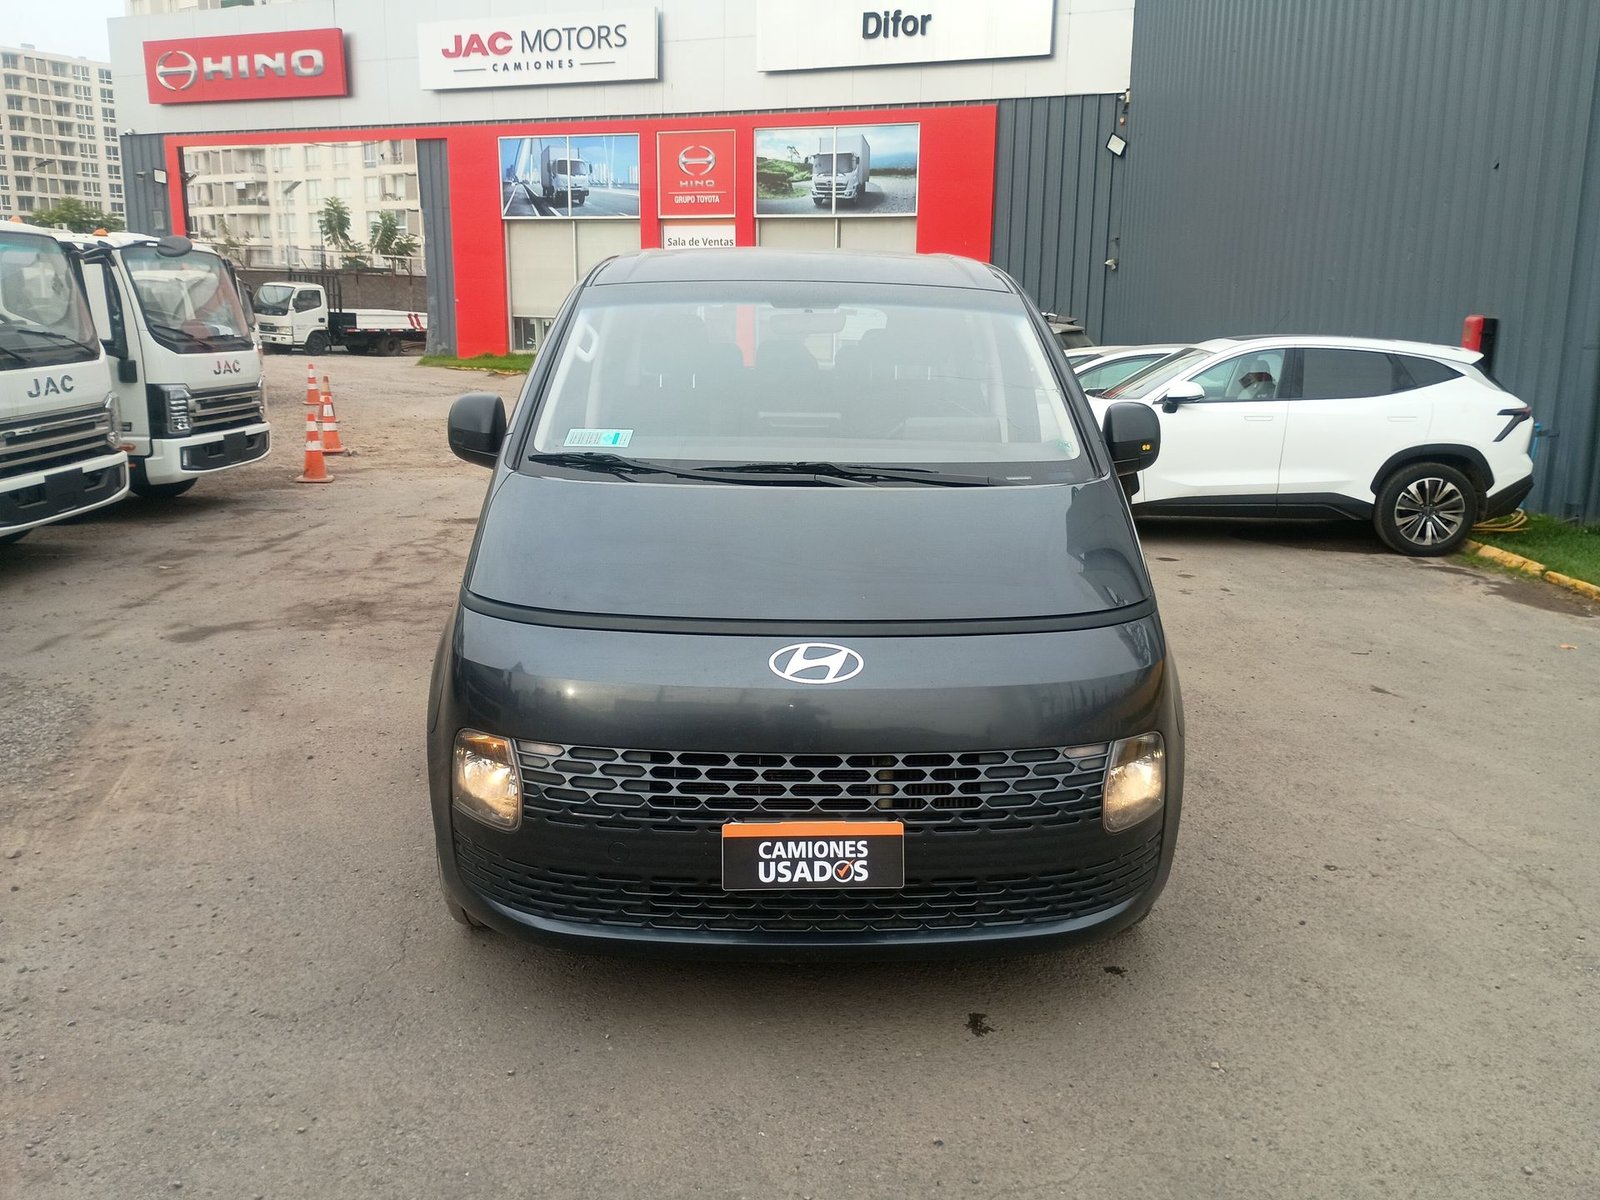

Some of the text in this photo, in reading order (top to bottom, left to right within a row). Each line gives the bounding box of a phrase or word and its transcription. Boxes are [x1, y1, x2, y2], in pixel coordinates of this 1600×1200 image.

[862, 9, 932, 39] Difor
[441, 24, 628, 59] JAC MOTORS
[202, 49, 325, 80] HINO
[492, 59, 575, 72] CAMIONES
[674, 195, 720, 204] GRUPO TOYOTA
[667, 237, 734, 246] Sala de Ventas
[213, 359, 241, 376] JAC
[27, 374, 75, 399] JAC
[758, 840, 869, 859] CAMIONES
[758, 859, 869, 883] USADOS
